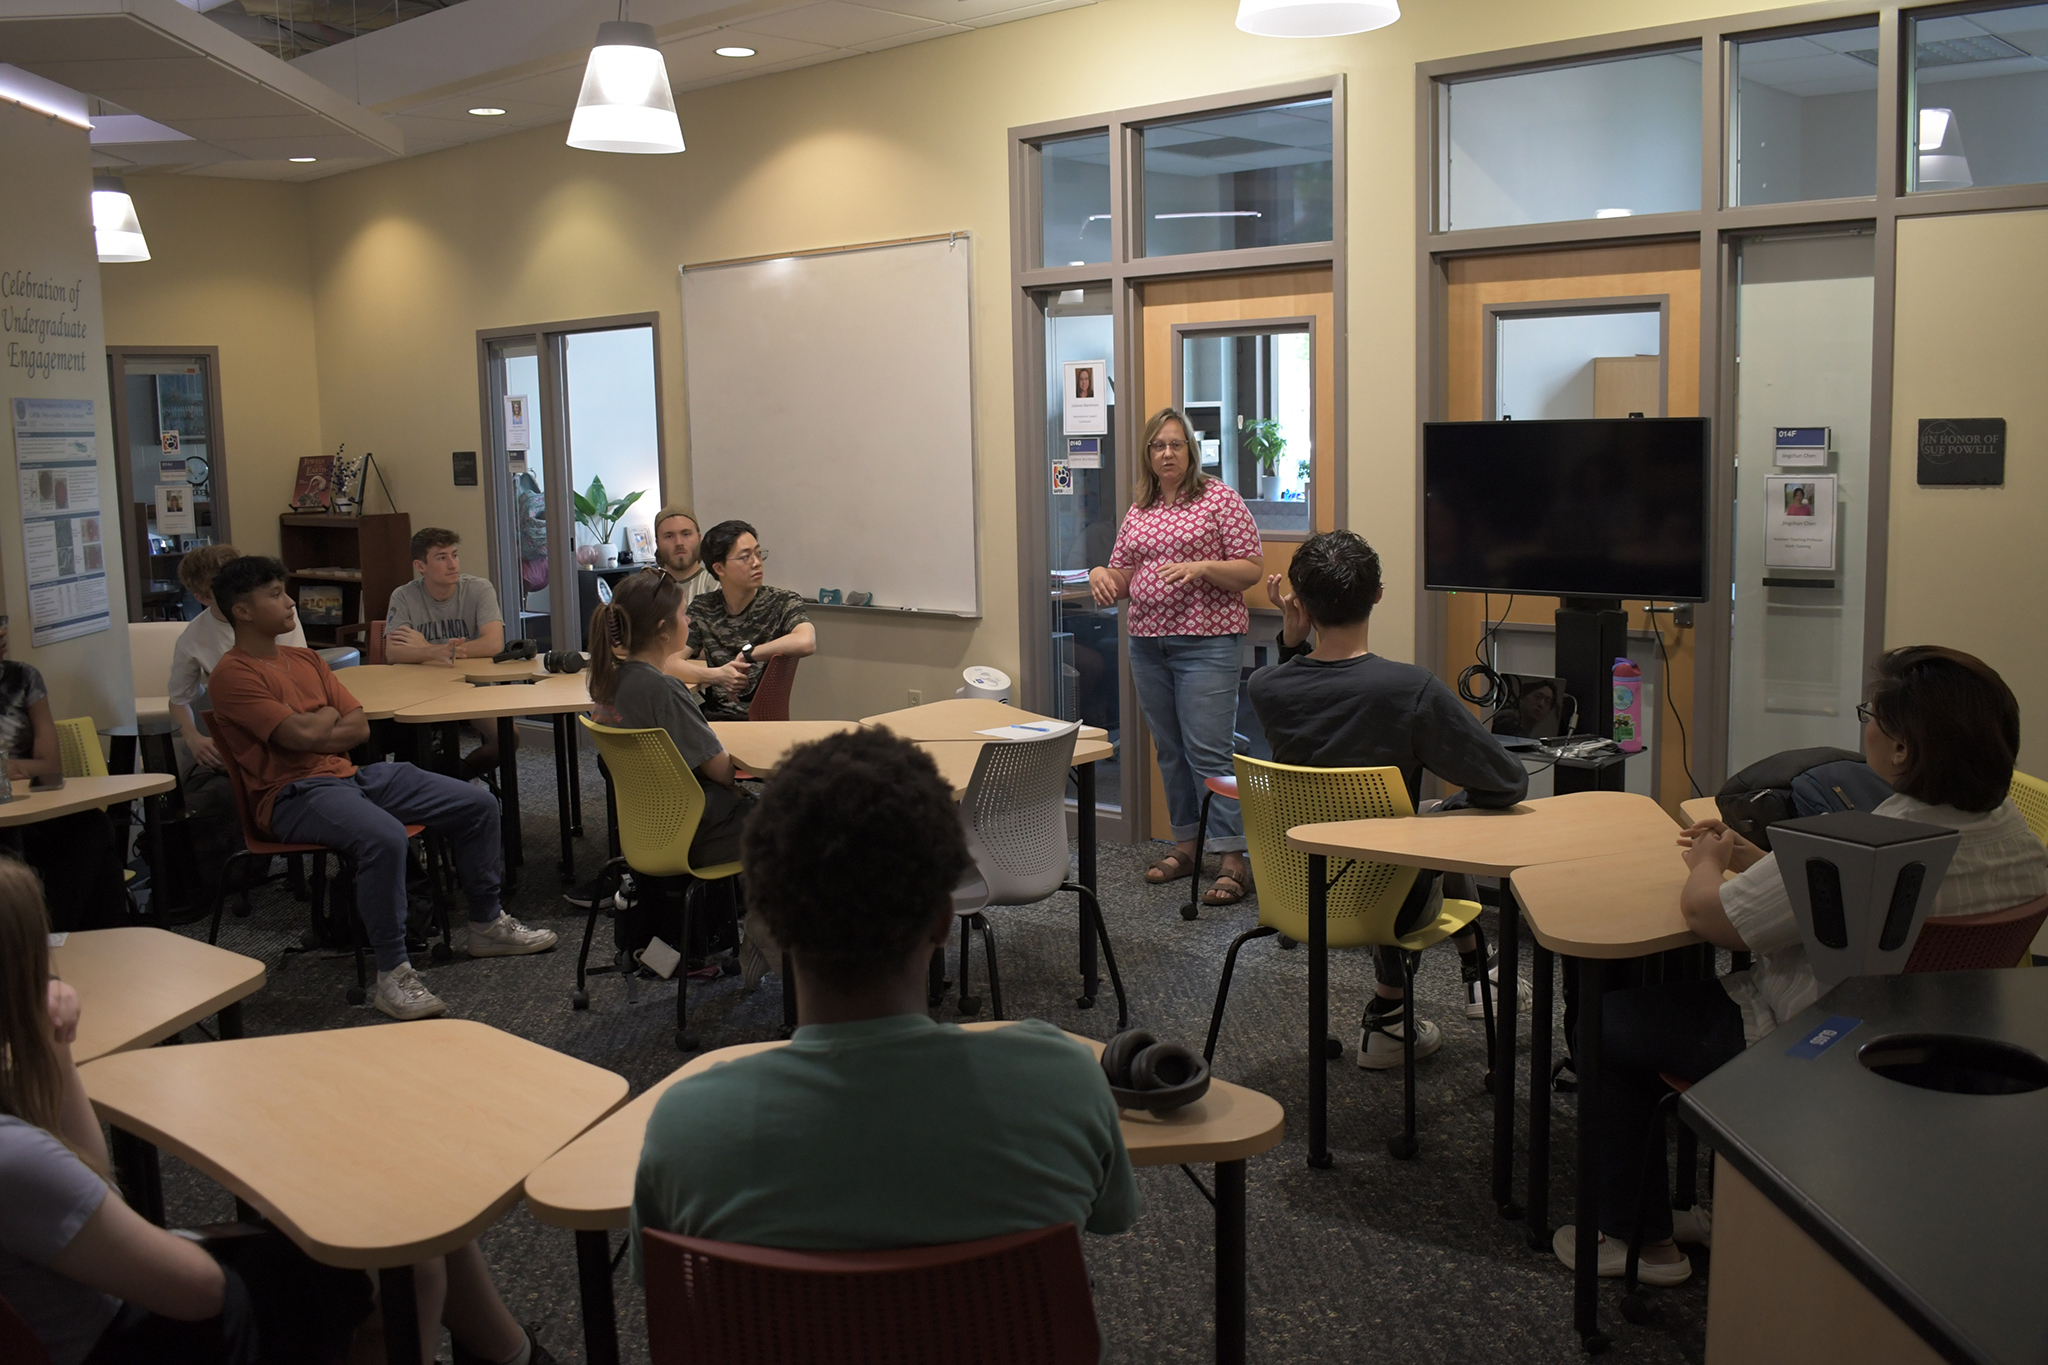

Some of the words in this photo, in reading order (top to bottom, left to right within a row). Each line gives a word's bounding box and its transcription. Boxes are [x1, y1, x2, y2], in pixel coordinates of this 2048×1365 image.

[1, 270, 66, 302] Celebration
[69, 279, 82, 312] of
[1, 306, 87, 344] Undergraduate
[7, 342, 87, 380] Engagement
[1778, 430, 1797, 438] 014F
[1925, 435, 1938, 444] IN
[1940, 434, 1981, 445] HONOR
[1984, 434, 2000, 444] OF
[1924, 445, 1945, 455] SUE
[1948, 445, 1997, 454] POWELL
